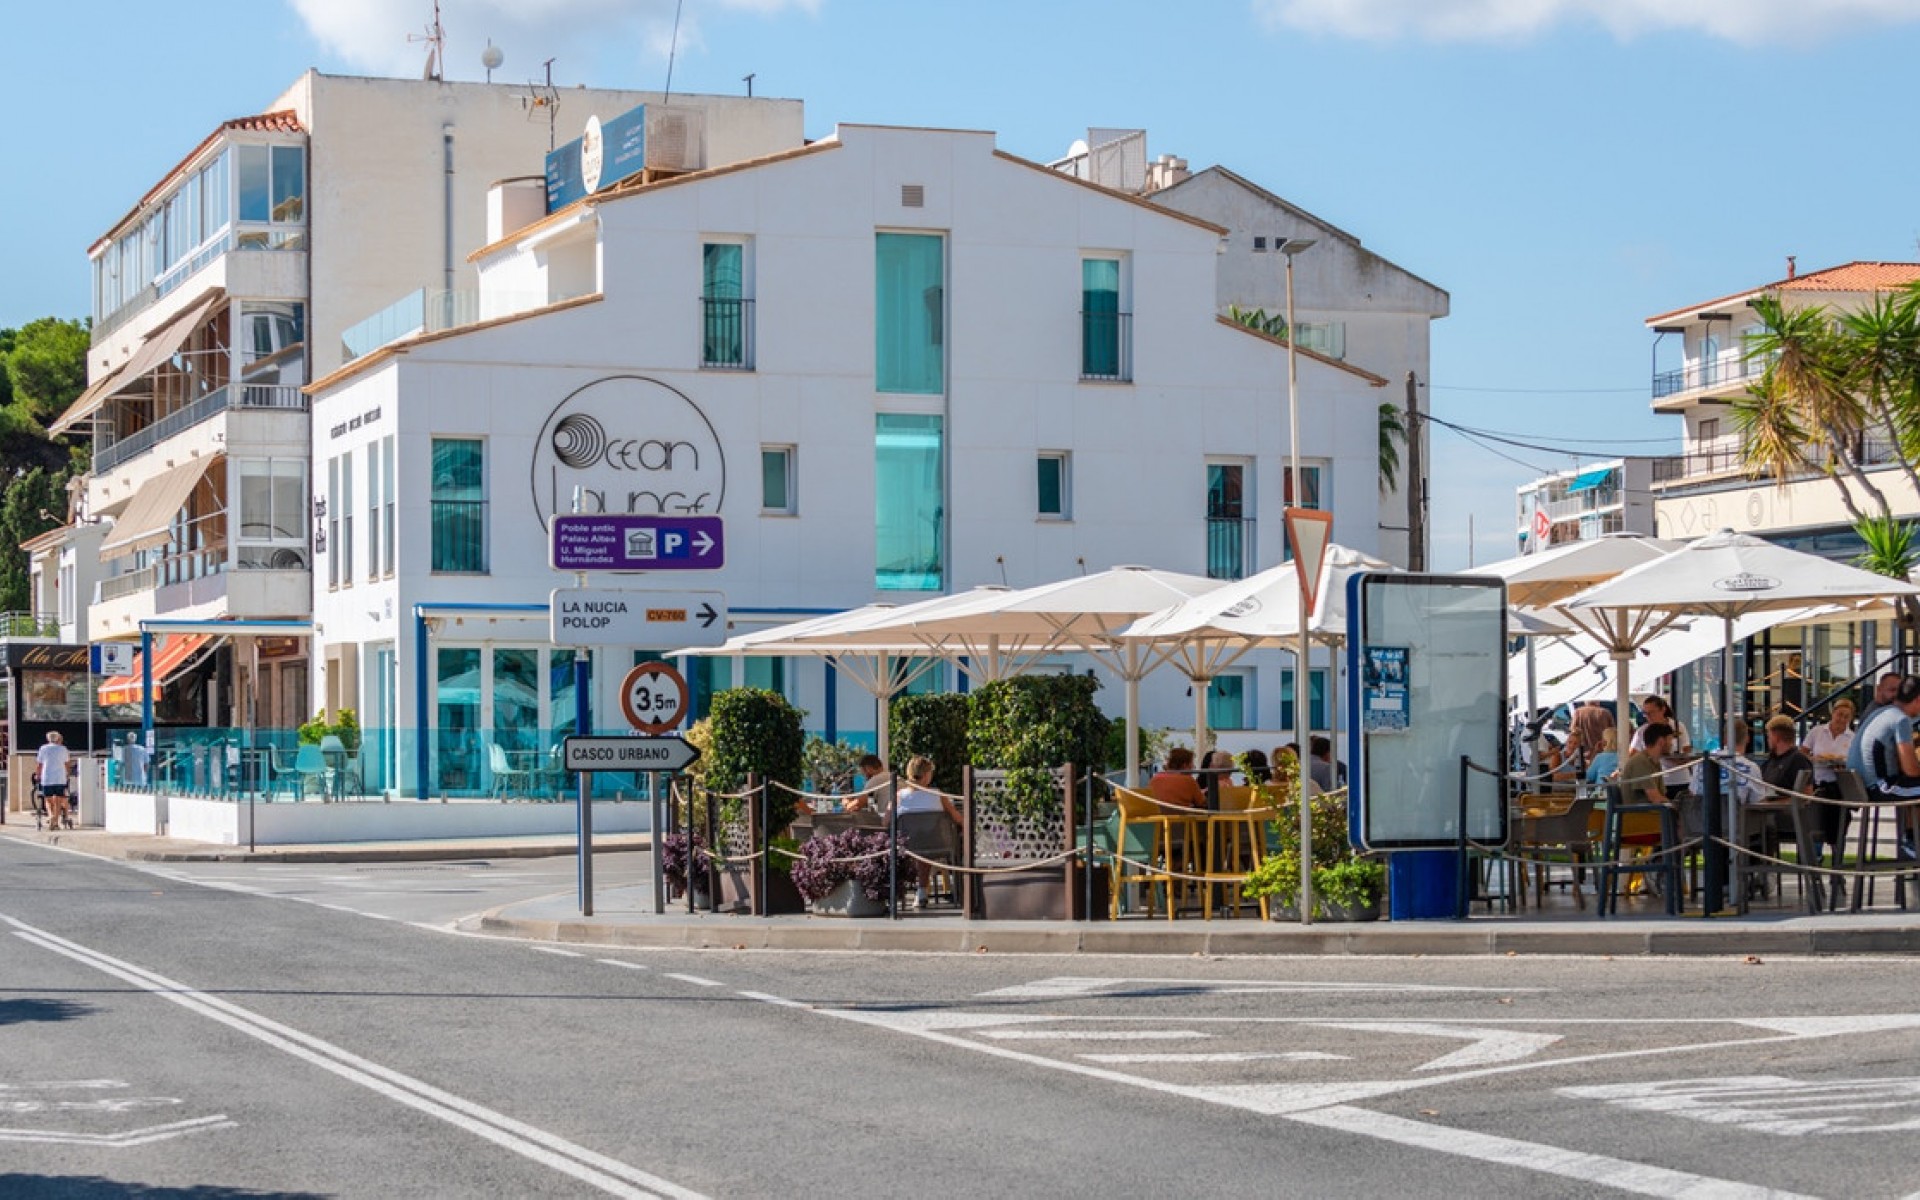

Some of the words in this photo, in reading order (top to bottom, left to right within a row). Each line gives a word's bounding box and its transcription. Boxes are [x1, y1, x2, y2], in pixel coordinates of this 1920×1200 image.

[561, 524, 589, 532] Poble
[591, 524, 616, 532] antic
[561, 535, 589, 543] Palau
[591, 535, 616, 543] Altea
[664, 533, 683, 554] P
[561, 546, 572, 554] U.
[573, 546, 607, 556] Miguel
[561, 555, 614, 563] Hernández
[562, 601, 580, 613] LA
[583, 601, 628, 613] NUCIA
[647, 609, 687, 621] CV-760
[563, 617, 611, 628] POLOP
[635, 687, 676, 711] 3,5m
[572, 747, 614, 761] CASCO
[617, 747, 670, 761] URBANO
